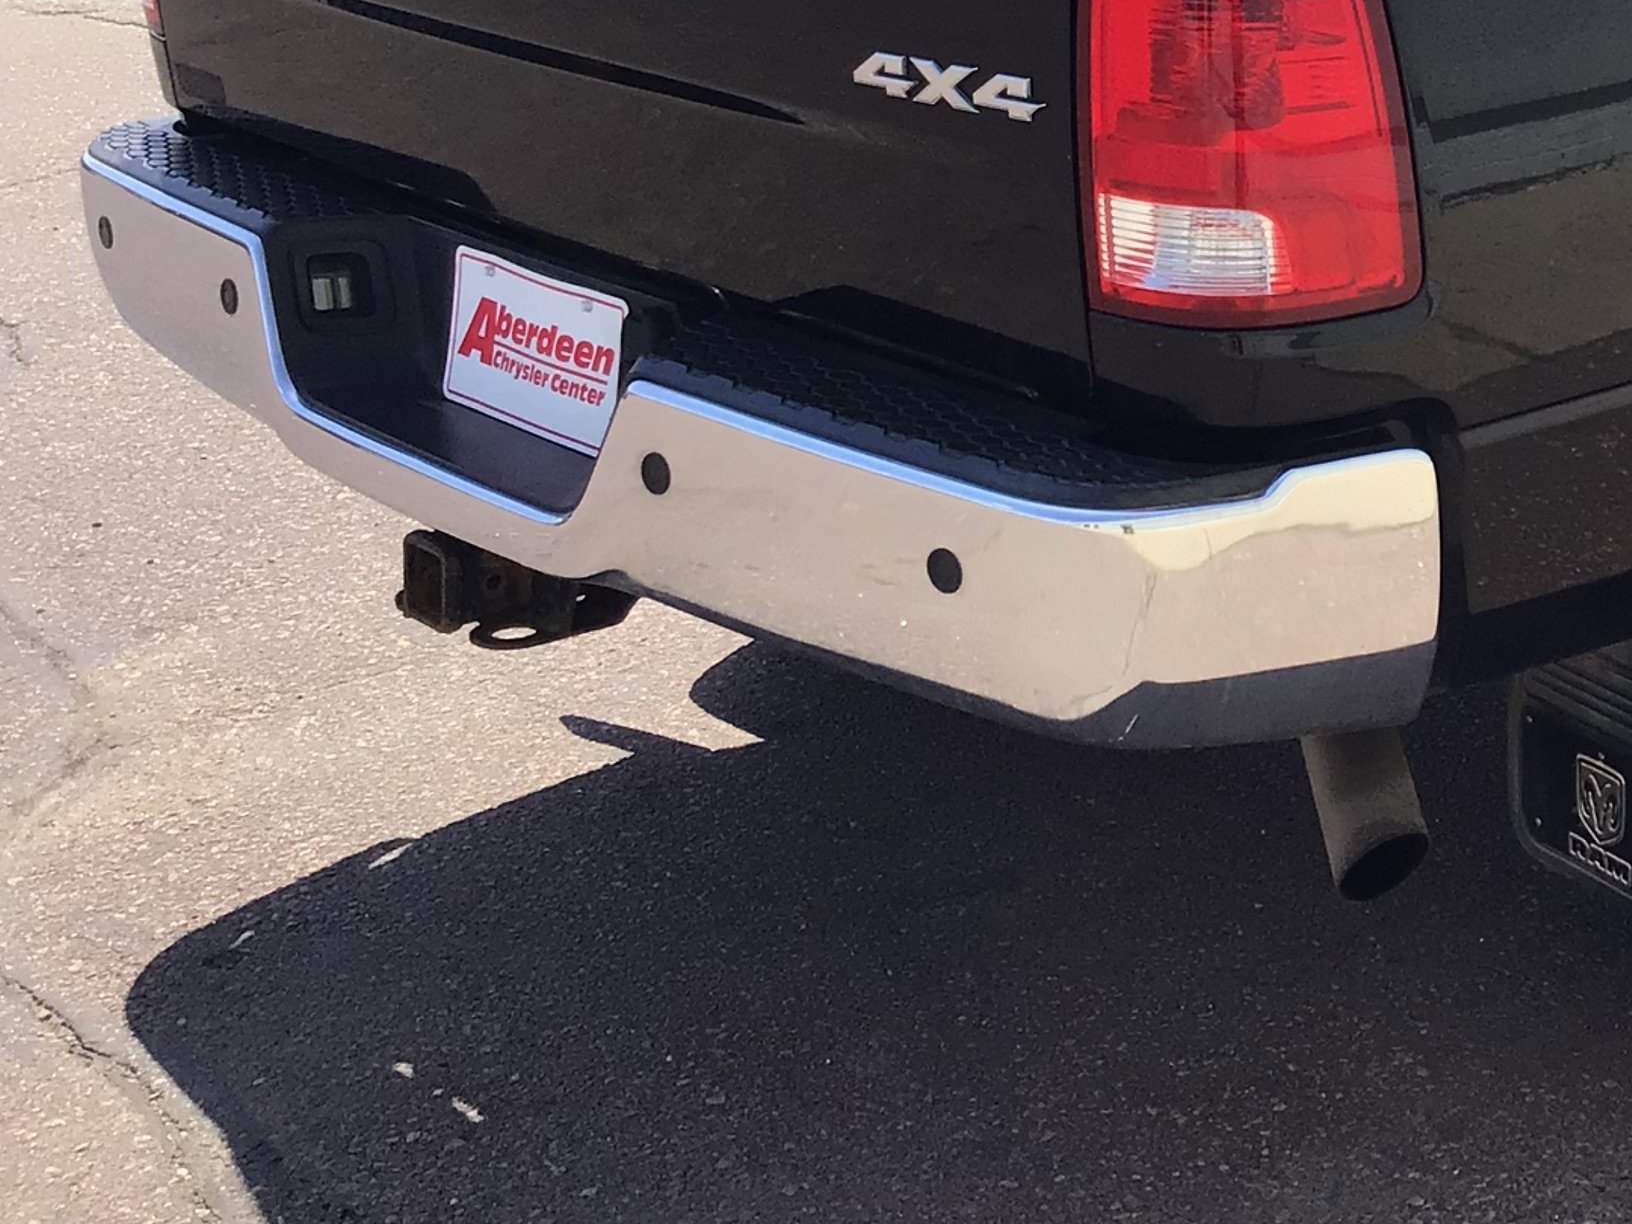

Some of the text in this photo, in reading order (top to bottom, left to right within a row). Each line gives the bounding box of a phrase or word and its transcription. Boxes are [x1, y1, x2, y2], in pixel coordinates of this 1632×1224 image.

[457, 296, 615, 376] Aberdeen
[493, 350, 606, 407] Chrysler Center
[1568, 831, 1632, 888] RAM
